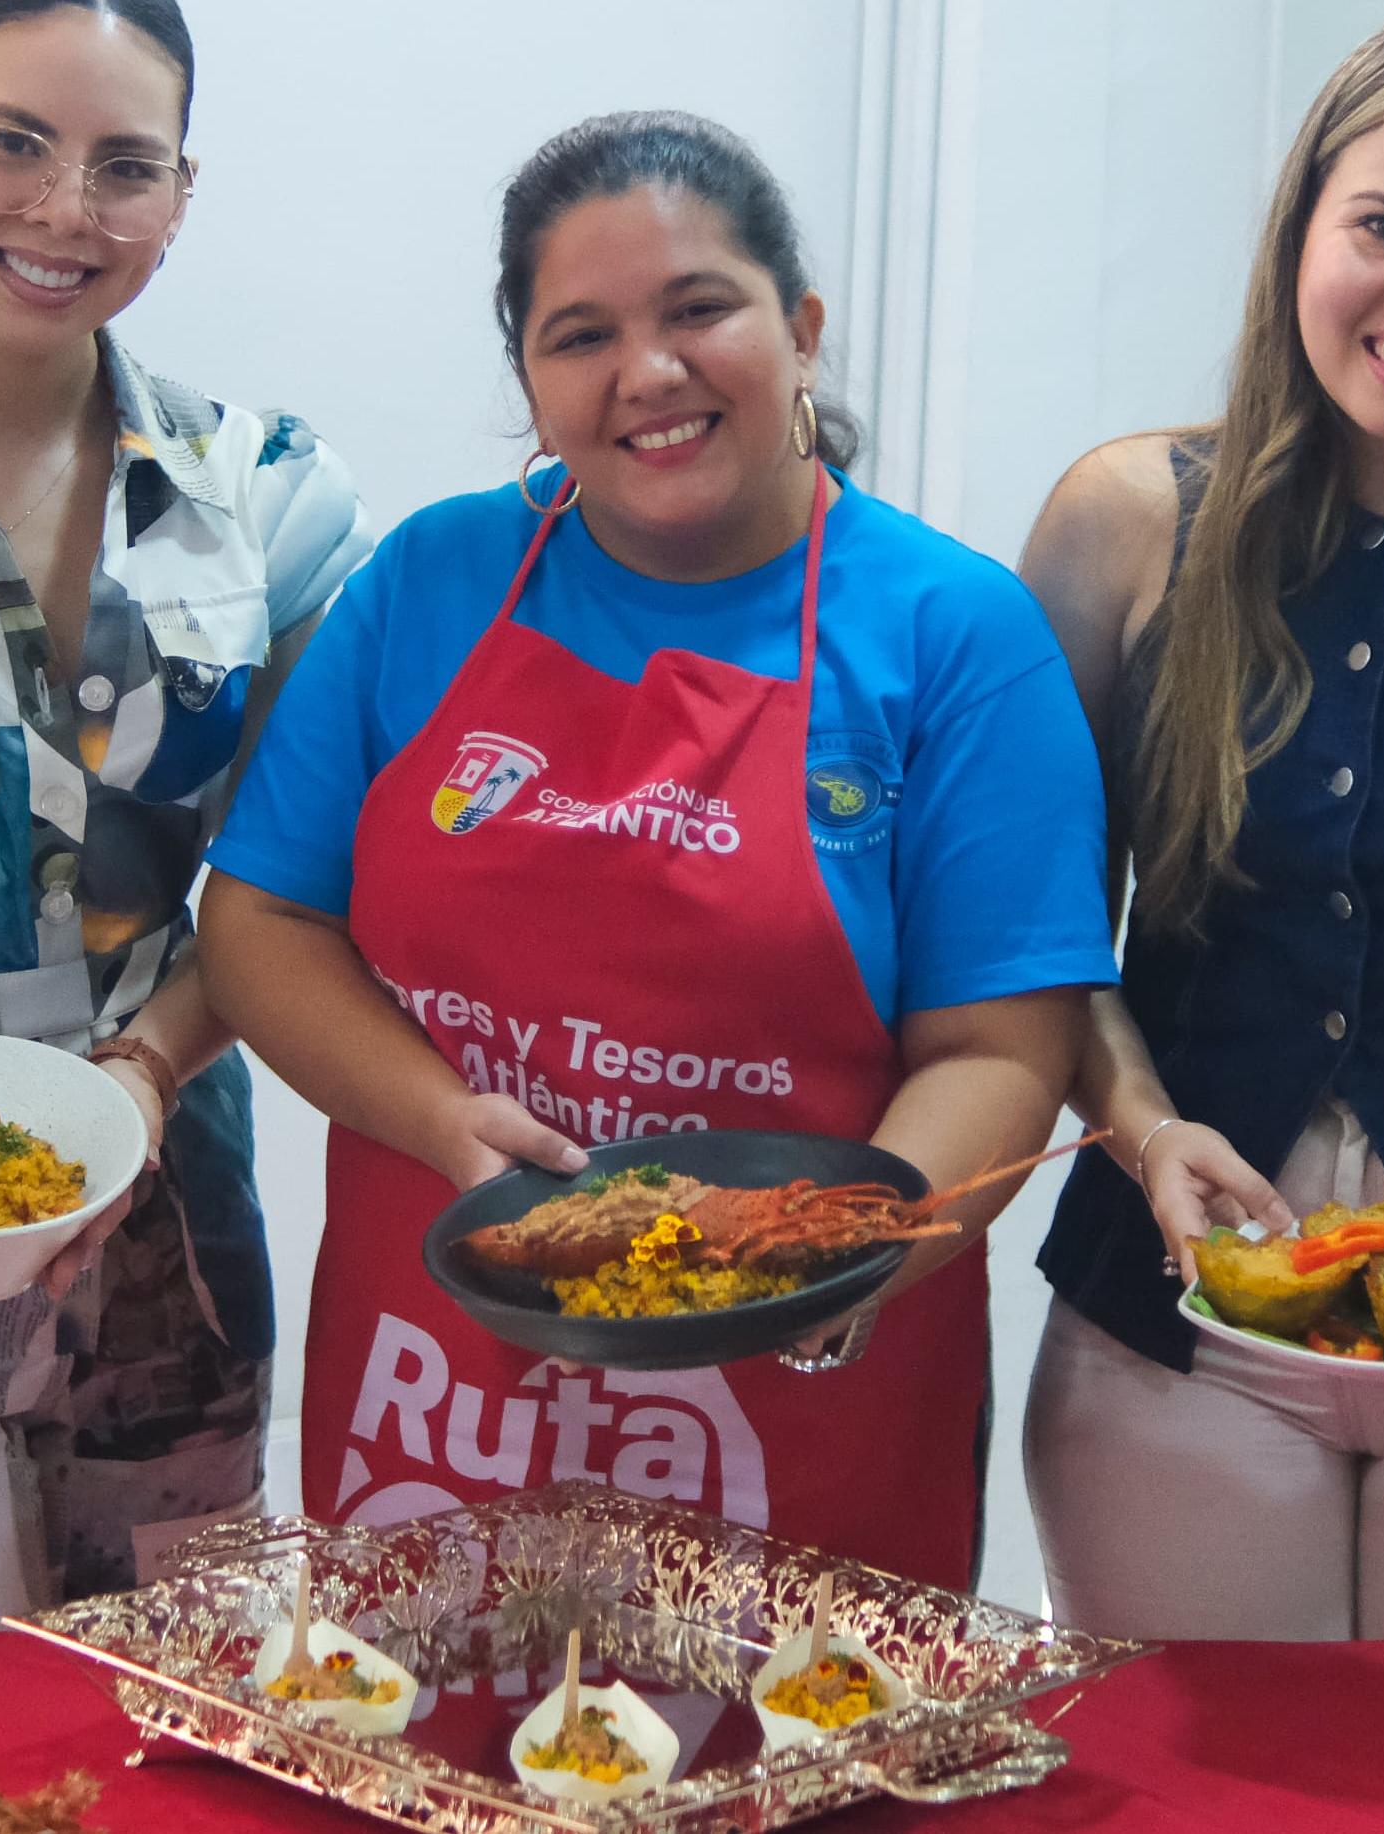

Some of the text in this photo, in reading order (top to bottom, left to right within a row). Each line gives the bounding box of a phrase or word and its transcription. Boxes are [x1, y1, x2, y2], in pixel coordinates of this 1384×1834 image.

[507, 1016, 540, 1061] y
[562, 1016, 793, 1096] Tesoros
[351, 1312, 708, 1503] Ruta
